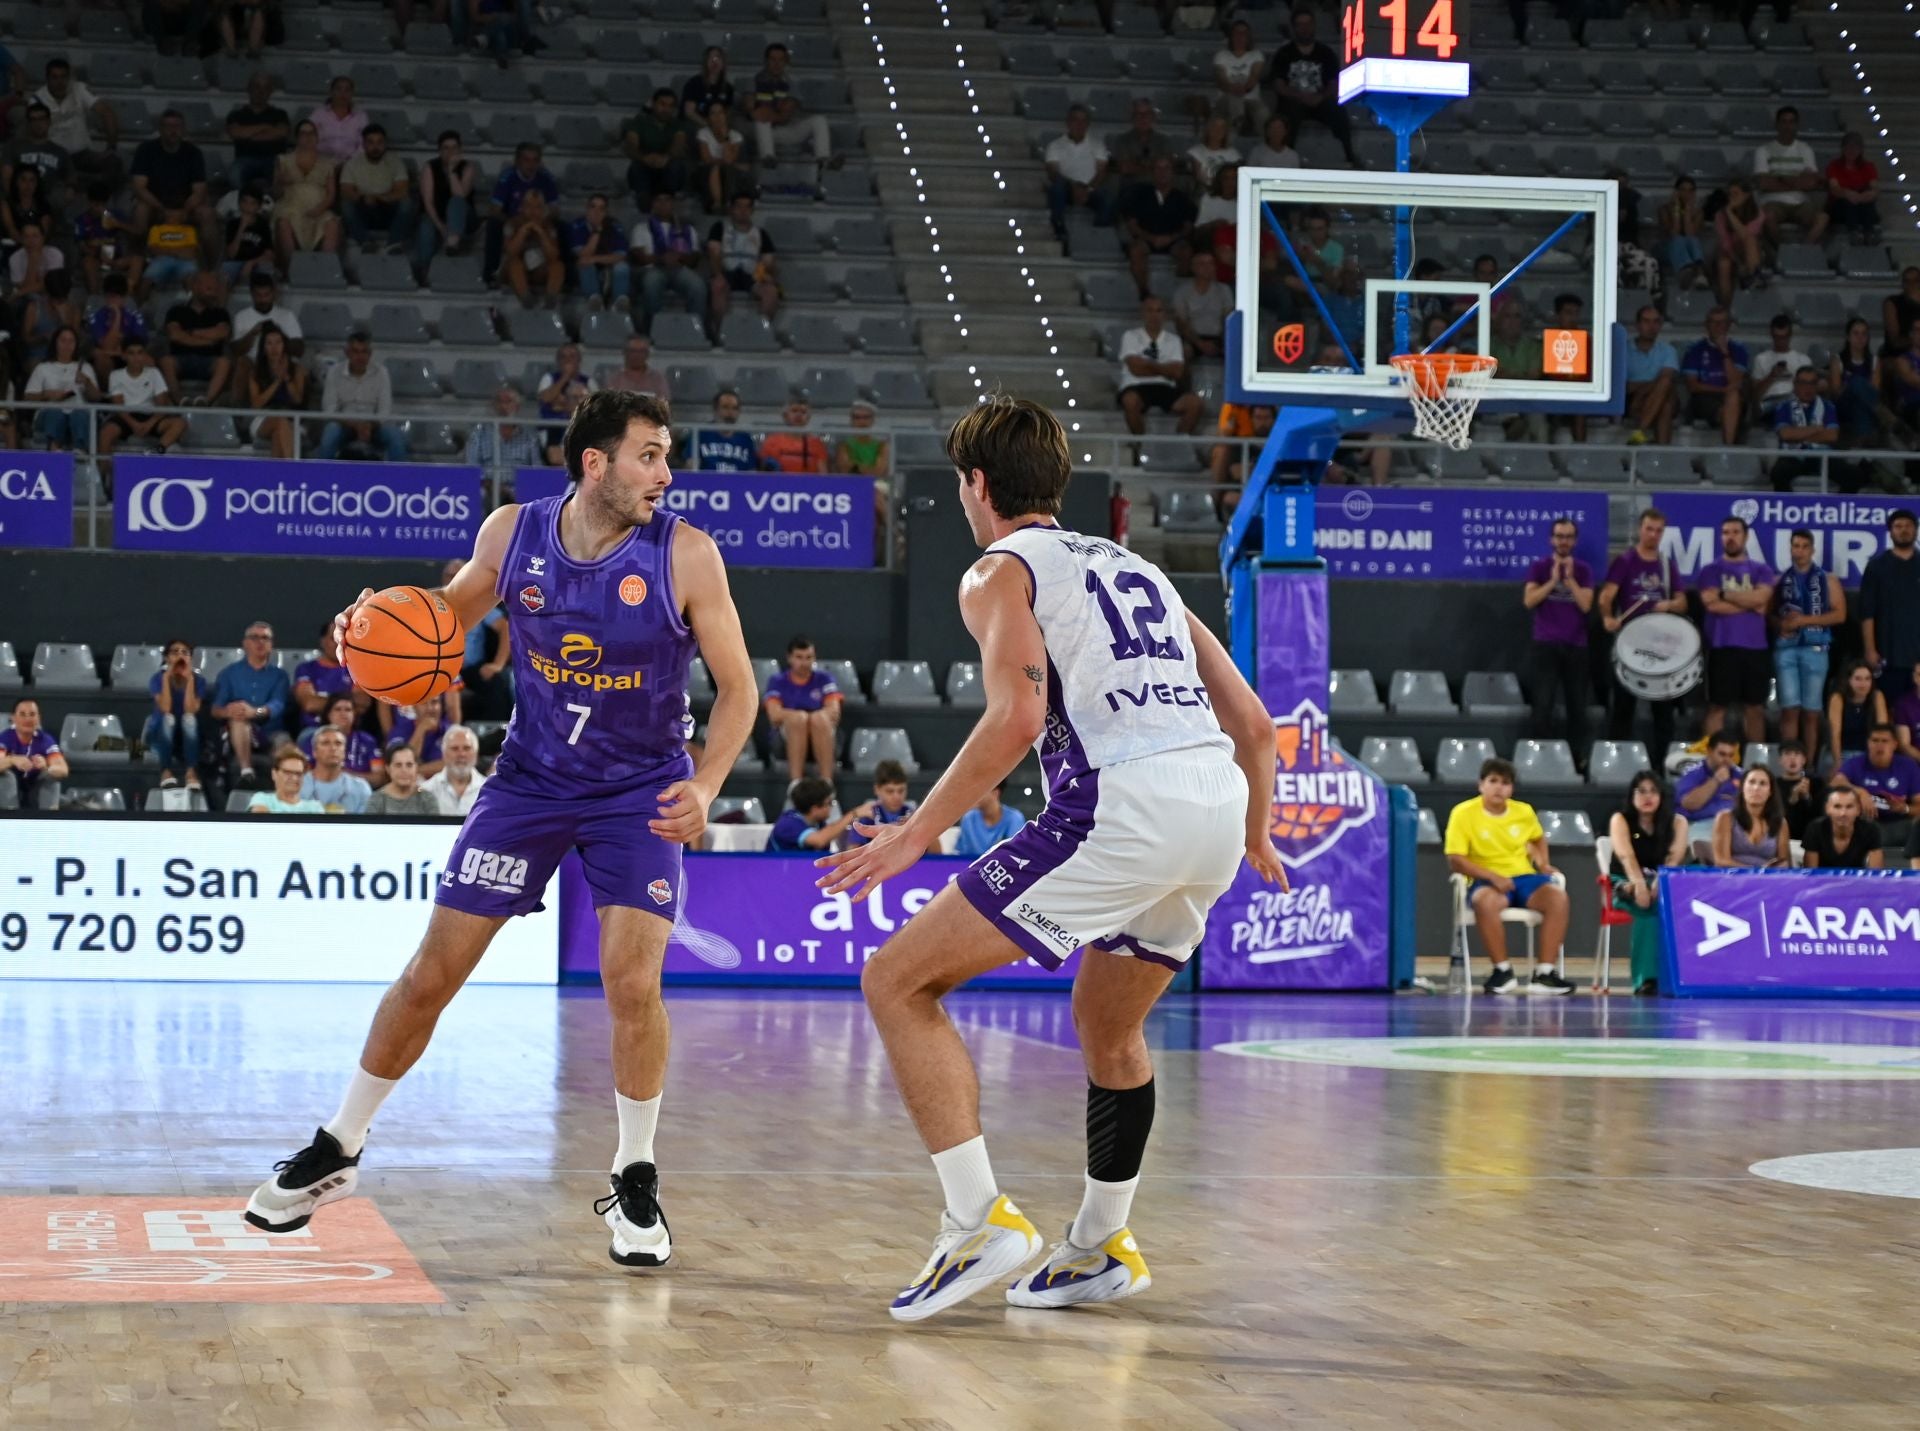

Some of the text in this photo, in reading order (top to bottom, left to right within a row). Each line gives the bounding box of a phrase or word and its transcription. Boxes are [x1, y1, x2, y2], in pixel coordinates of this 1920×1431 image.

[1342, 0, 1365, 63] 14
[1379, 0, 1459, 58] 14
[0, 469, 57, 500] CA
[745, 491, 852, 514] varas
[1462, 508, 1586, 521] RESTAURANTE
[379, 526, 388, 537] Y
[757, 517, 851, 549] dental
[1371, 529, 1433, 551] DANI
[1462, 523, 1535, 537] COMIDAS
[1463, 539, 1516, 551] TAPAS
[1085, 568, 1184, 661] 12
[531, 658, 641, 692] agropal
[566, 702, 591, 746] 7
[1273, 770, 1364, 808] ENCIA
[163, 858, 259, 899] San
[458, 847, 528, 886] gaza
[983, 859, 1014, 891] CBC
[1247, 884, 1332, 922] JUEGA
[47, 913, 137, 952] 720
[156, 914, 245, 954] 659
[1231, 910, 1353, 953] PALENCIA
[1780, 905, 1920, 942] ARAM
[757, 938, 822, 964] IoT
